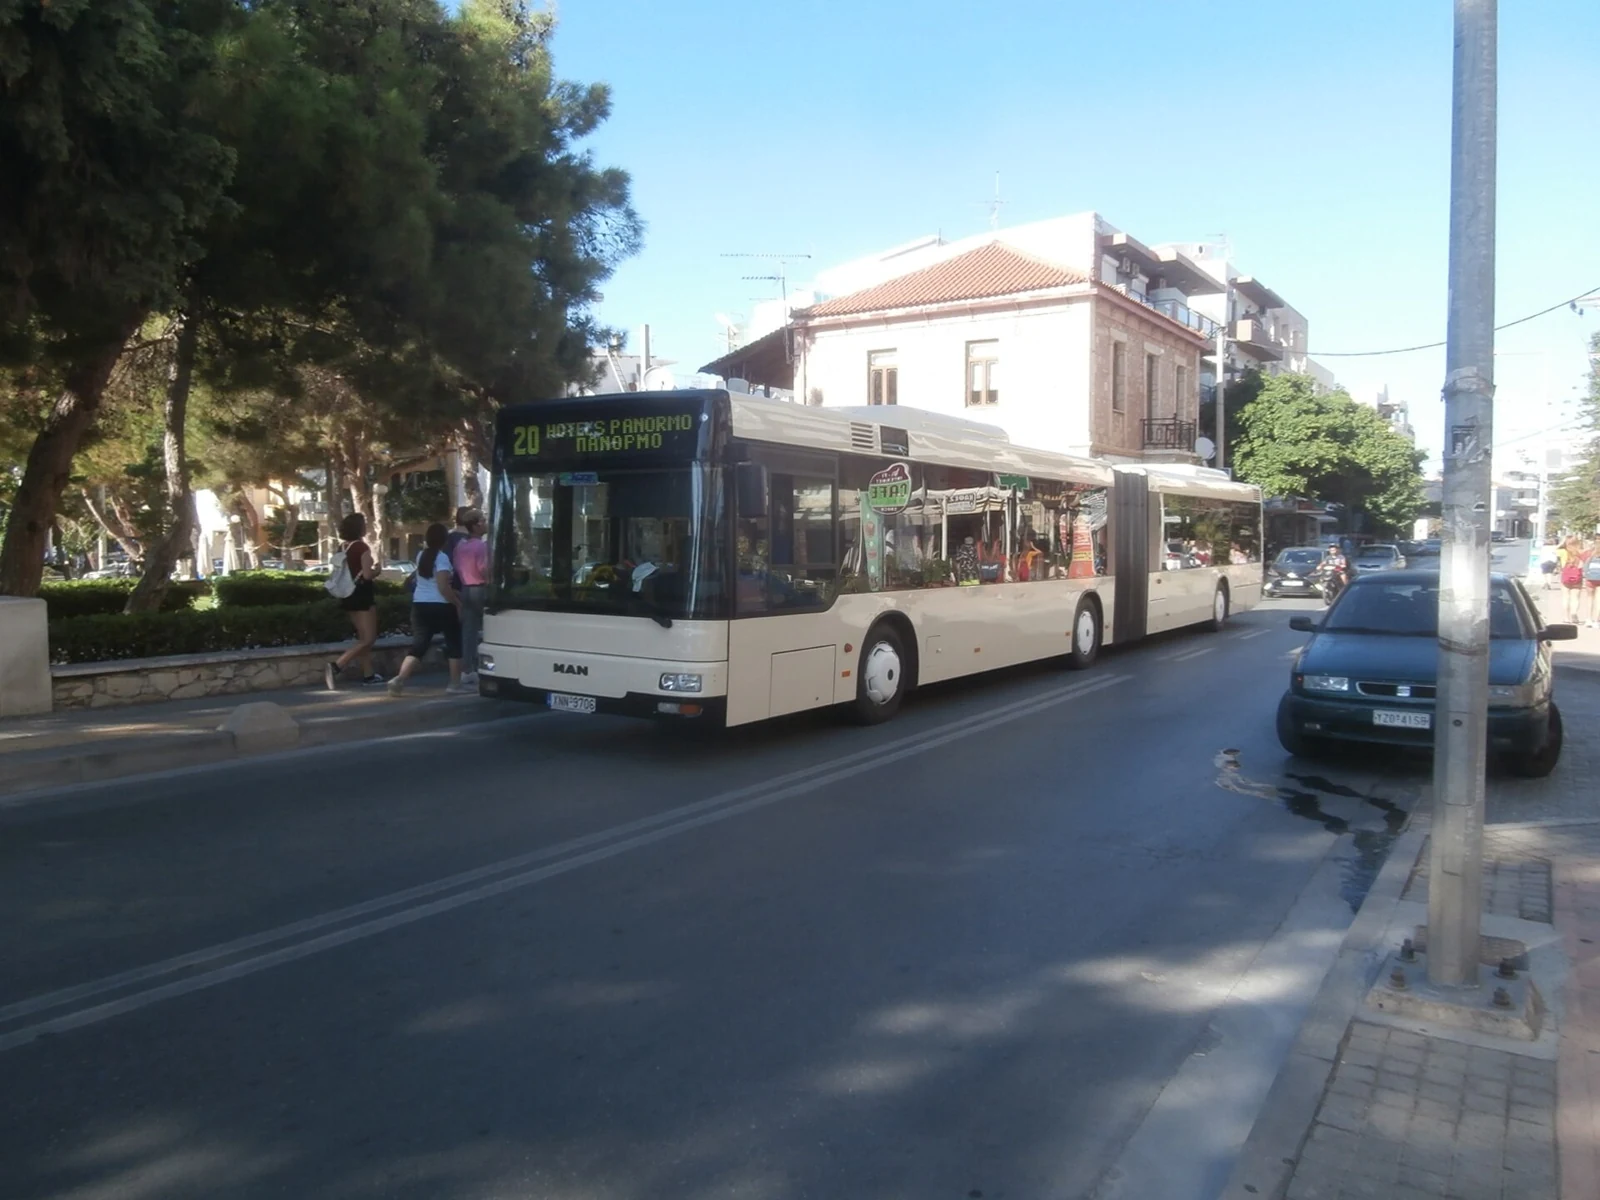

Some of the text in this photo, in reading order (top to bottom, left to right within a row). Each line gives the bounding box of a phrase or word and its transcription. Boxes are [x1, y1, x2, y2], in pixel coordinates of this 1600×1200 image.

[610, 414, 692, 435] PANORMO
[513, 425, 540, 456] 20
[553, 662, 588, 676] MAN
